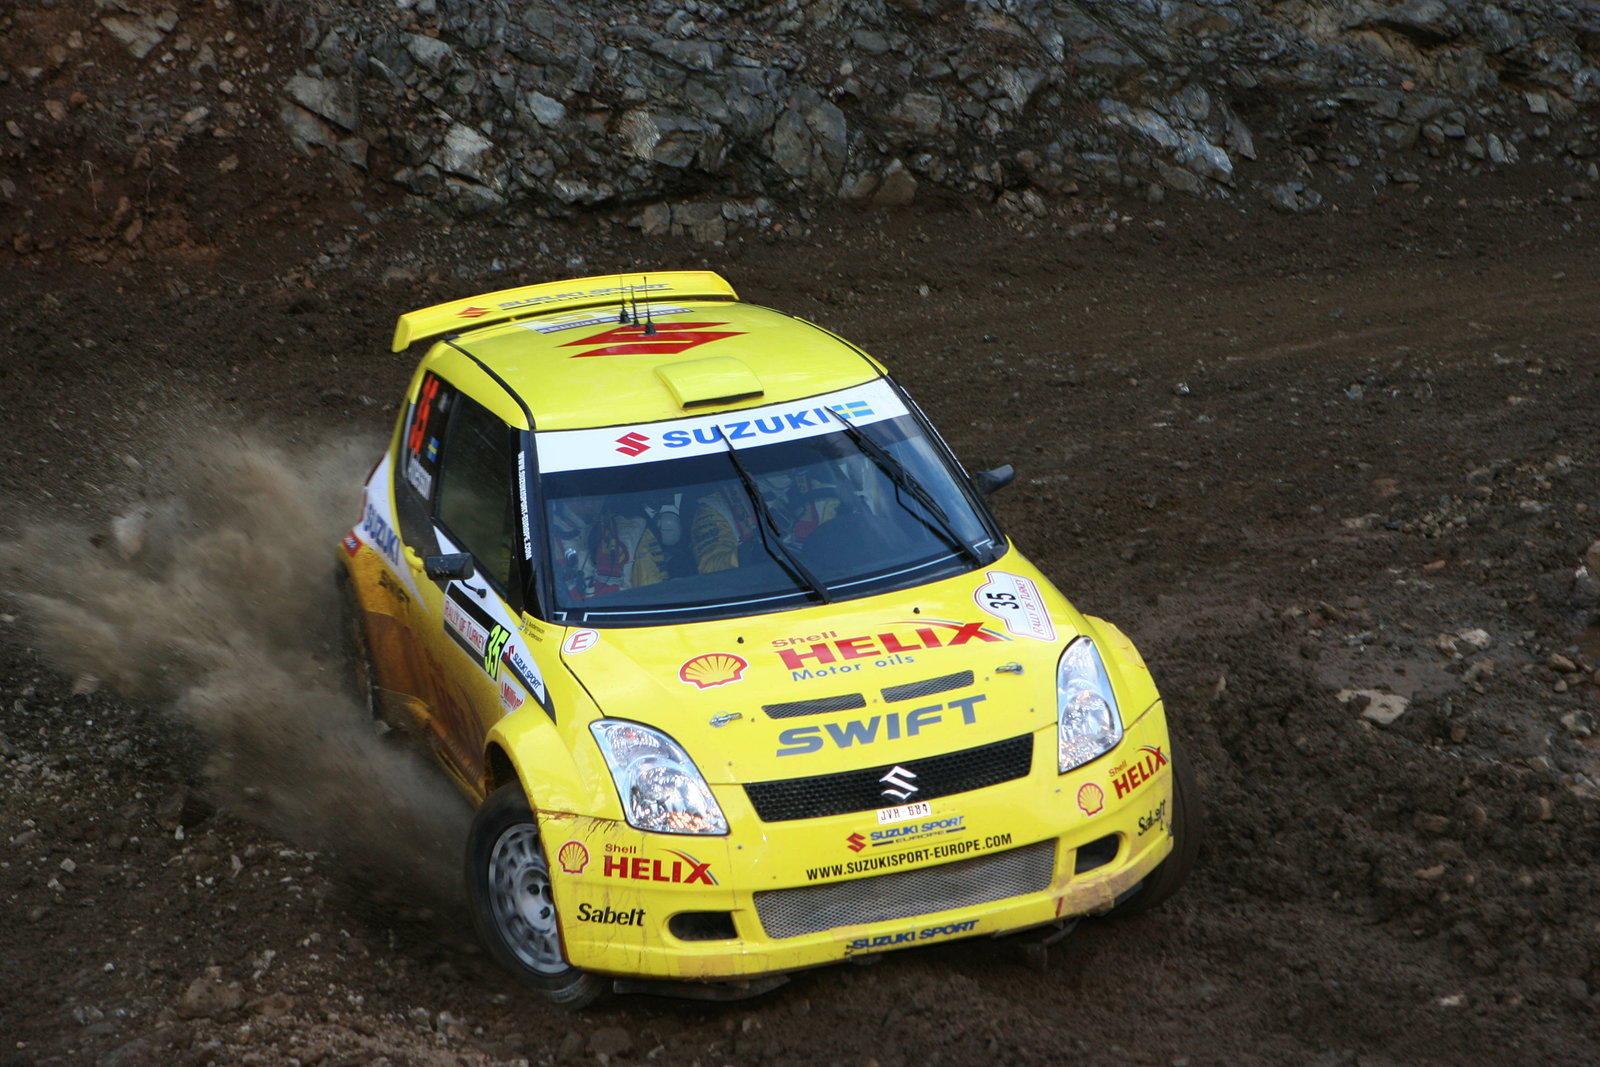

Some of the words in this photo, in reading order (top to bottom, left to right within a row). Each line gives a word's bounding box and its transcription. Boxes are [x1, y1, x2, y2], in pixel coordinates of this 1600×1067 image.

[662, 407, 831, 449] SUZUKI
[985, 592, 1020, 609] 35
[484, 624, 509, 678] 35
[570, 632, 592, 650] E
[771, 630, 838, 648] Shell
[774, 621, 1004, 671] HELIX
[512, 652, 527, 675] SUZUKI
[525, 669, 541, 689] SPORT
[791, 662, 862, 682] Motor
[874, 653, 915, 668] oils
[776, 693, 987, 758] SWIFT
[1112, 746, 1167, 800] HELIX
[870, 824, 918, 841] SUZUKI
[920, 815, 965, 832] SPORT
[895, 830, 946, 844] EUROPE
[605, 843, 637, 854] Shell
[806, 833, 1013, 881] WWW.SUZUKISPORT-EUROPE.COM
[603, 855, 714, 886] HELIX
[576, 902, 646, 927] Sabelt
[850, 930, 916, 950] SUZUKI
[919, 919, 980, 939] SPORT
